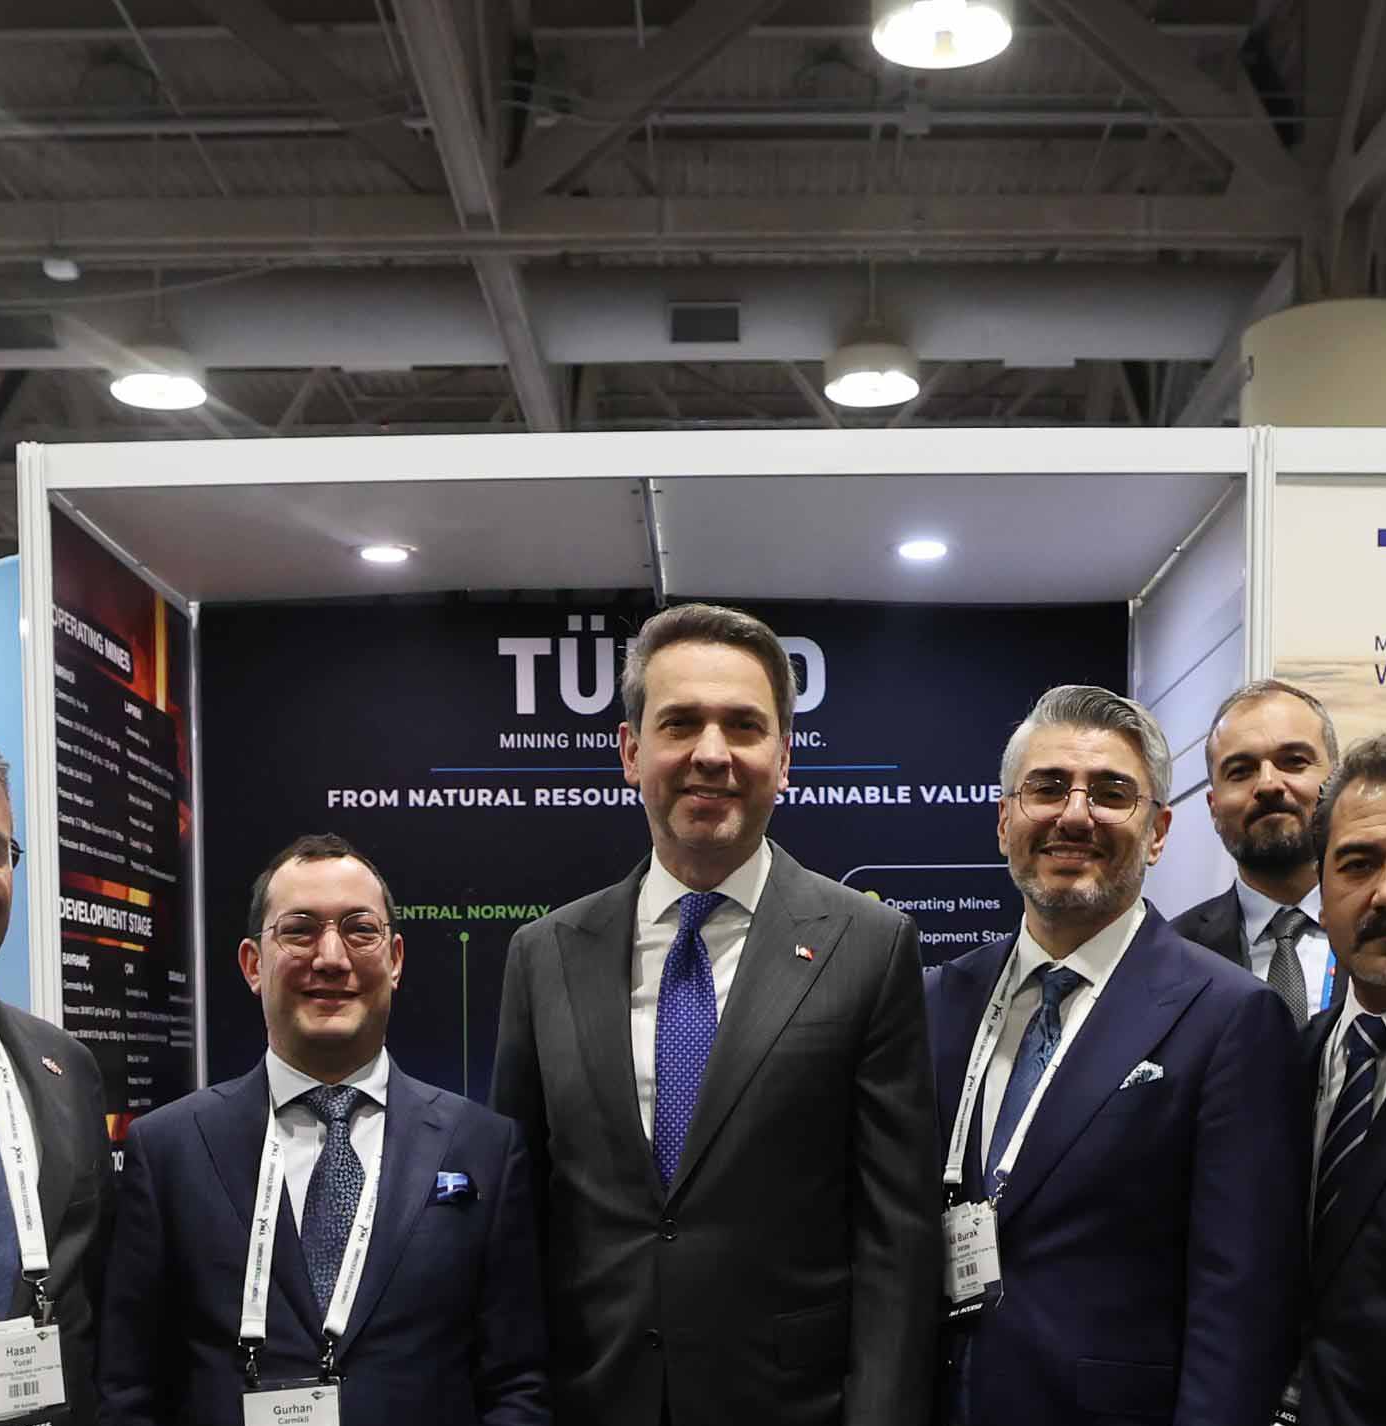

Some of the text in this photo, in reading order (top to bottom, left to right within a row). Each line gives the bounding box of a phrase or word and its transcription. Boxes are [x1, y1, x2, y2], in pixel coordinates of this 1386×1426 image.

[104, 638, 131, 673] MINES
[498, 614, 827, 715] TÜD
[499, 732, 569, 749] MINING
[575, 733, 621, 749] INDU
[327, 789, 398, 808] FROM
[408, 788, 527, 808] NATURAL
[393, 904, 551, 920] ENTRAL NORWAY
[884, 896, 1001, 913] Operating Mines
[59, 896, 154, 937] DEVELOPMENT STAGE
[919, 931, 979, 947] lopment
[6, 1345, 37, 1358] Hasan
[273, 1403, 313, 1416] Gurhan
